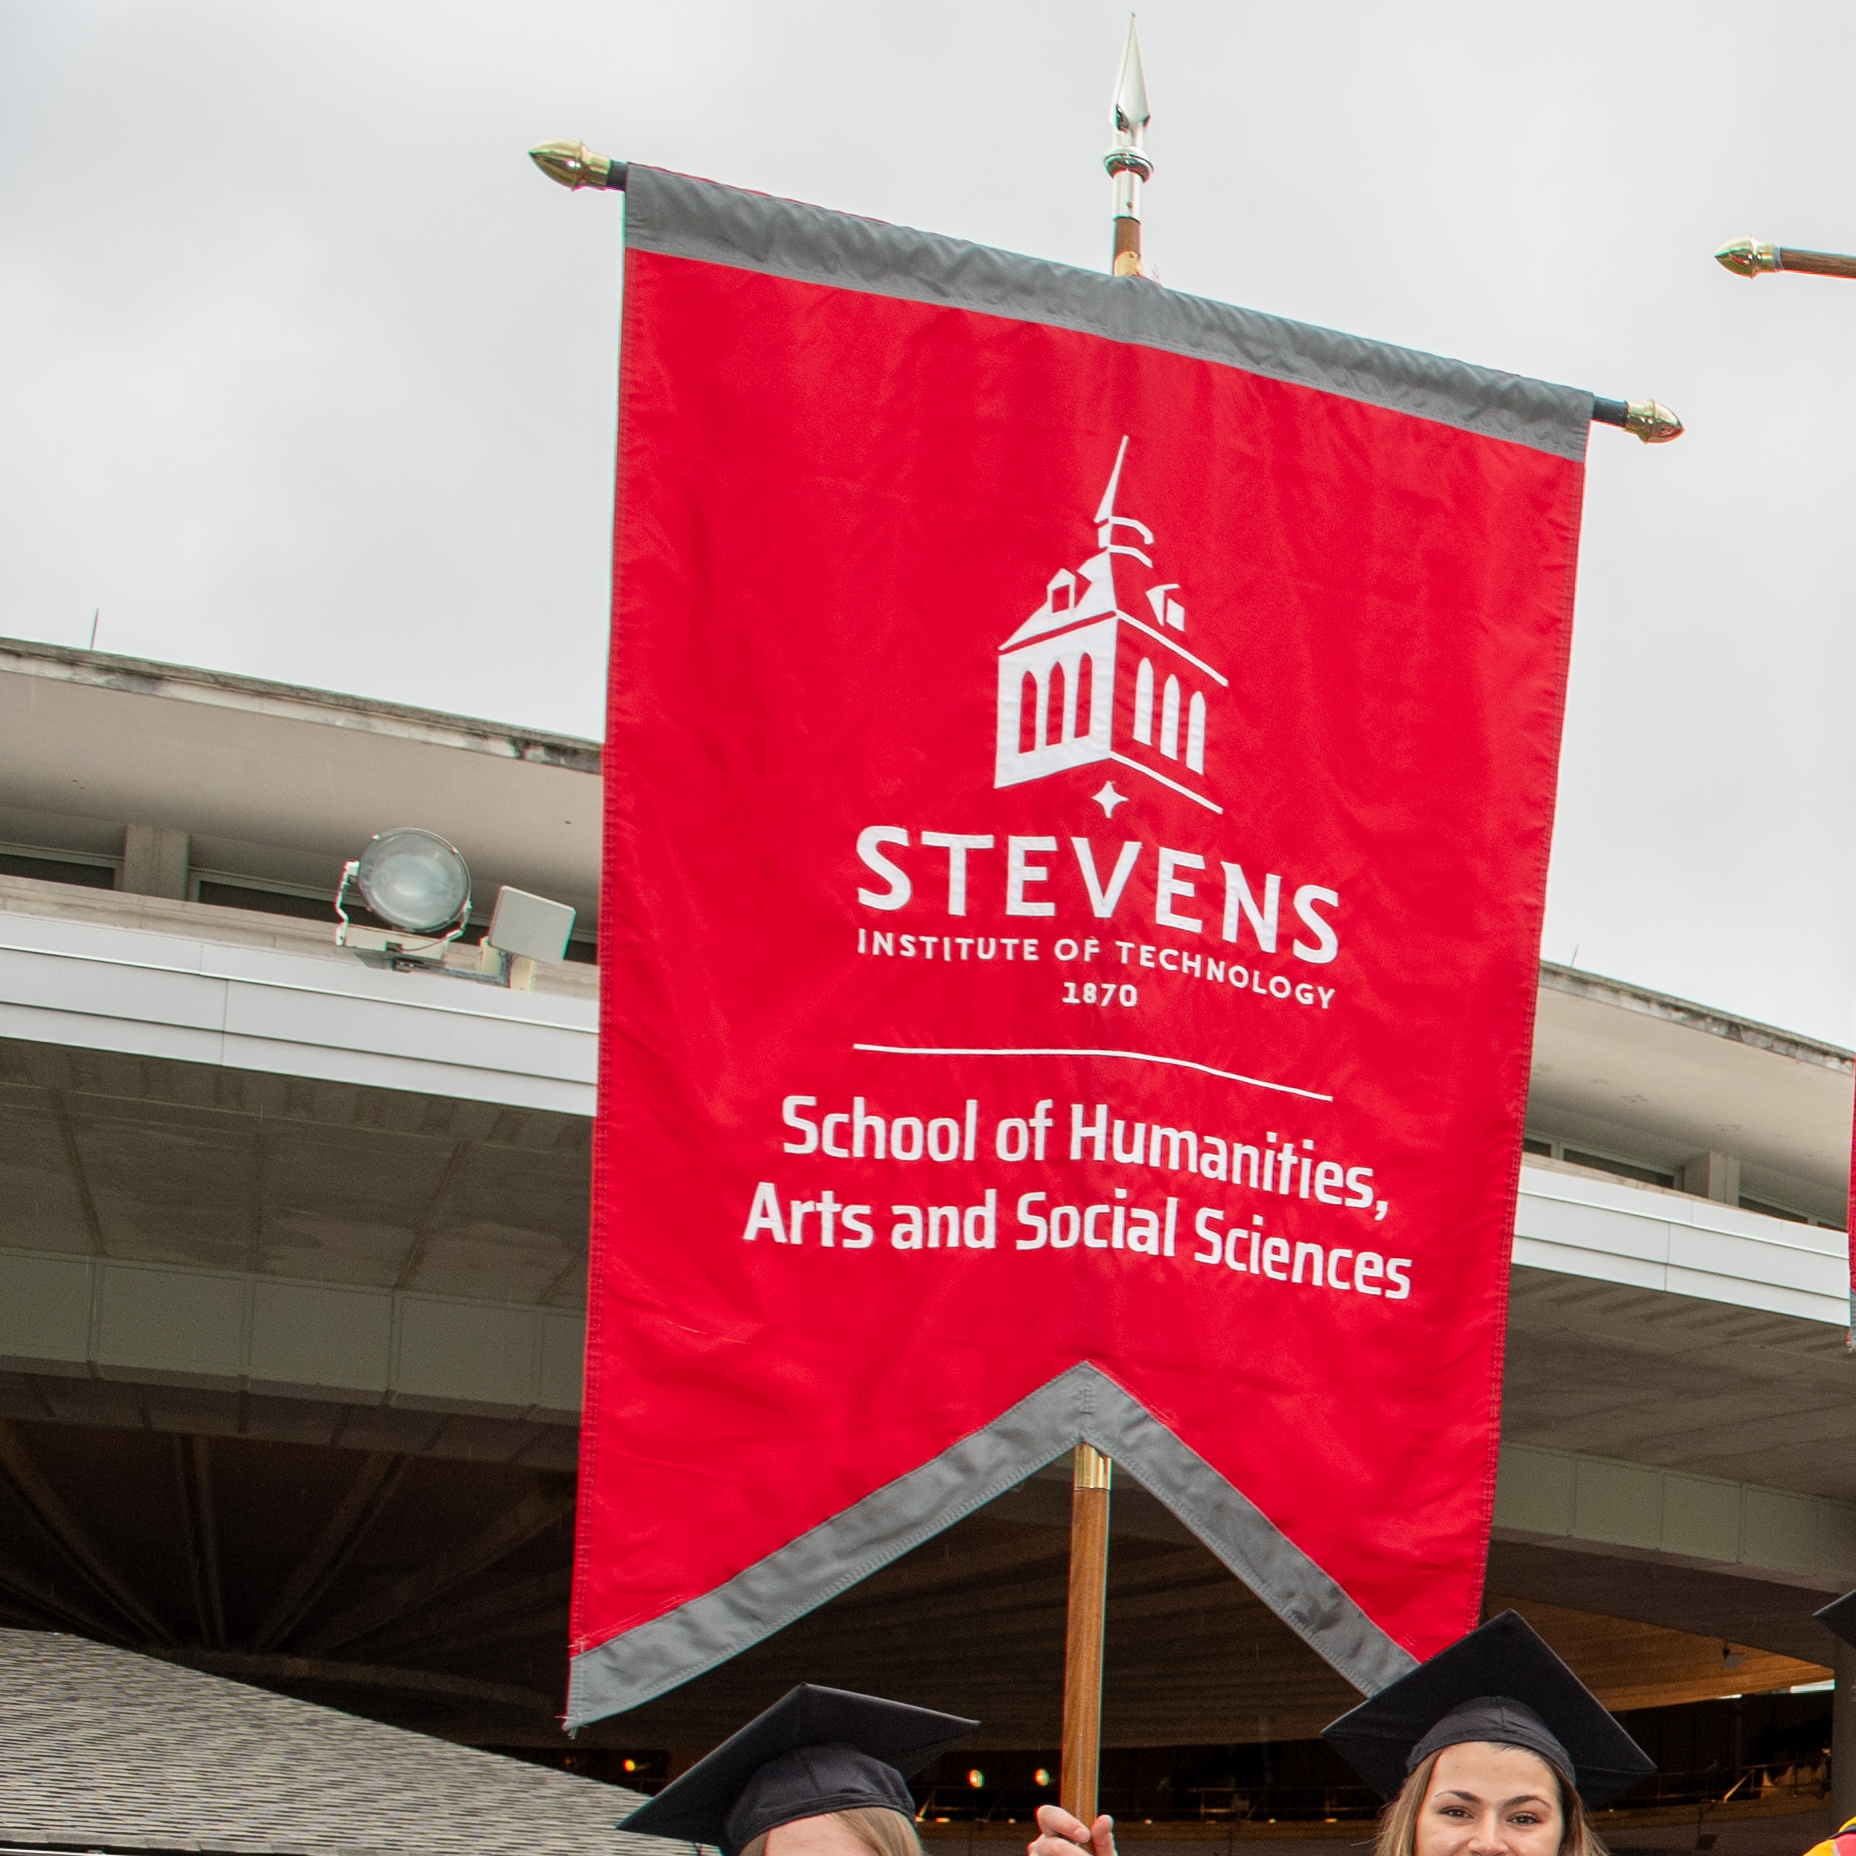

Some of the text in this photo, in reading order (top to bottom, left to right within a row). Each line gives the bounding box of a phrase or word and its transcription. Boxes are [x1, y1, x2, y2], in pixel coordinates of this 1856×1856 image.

[857, 826, 1338, 963] STEVENS
[858, 929, 1334, 1008] INSTITUTE OF TECHNOLOGY
[1063, 982, 1137, 1006] 1870
[783, 1096, 1388, 1220] School of Humanities,
[744, 1182, 1411, 1299] Arts and Social Sciences
